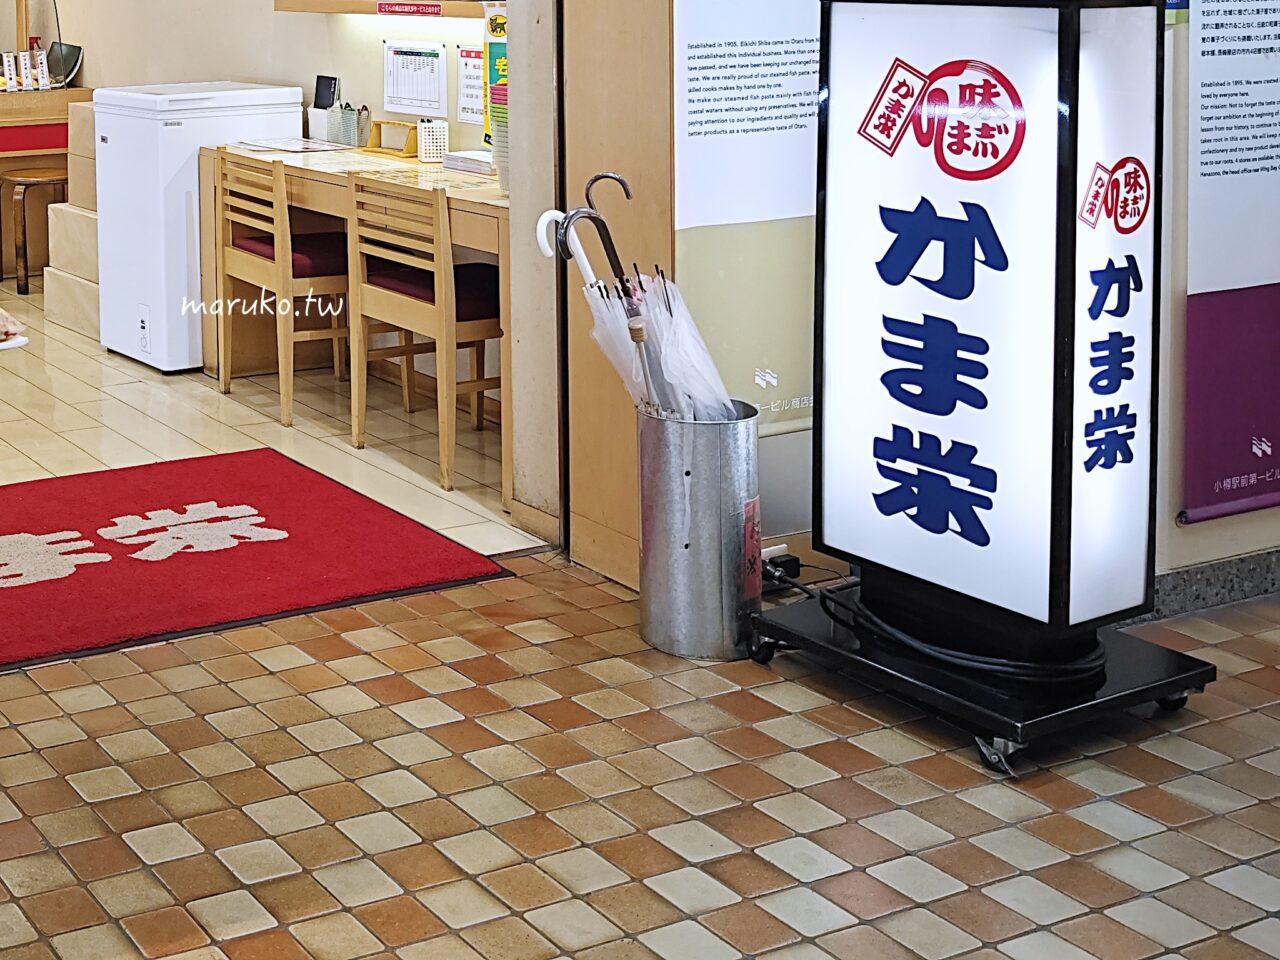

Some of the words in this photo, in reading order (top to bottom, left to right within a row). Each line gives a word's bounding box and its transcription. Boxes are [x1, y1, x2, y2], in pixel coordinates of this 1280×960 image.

[873, 78, 915, 146] かま栄
[871, 195, 1009, 547] かま栄
[1083, 254, 1143, 473] かま栄
